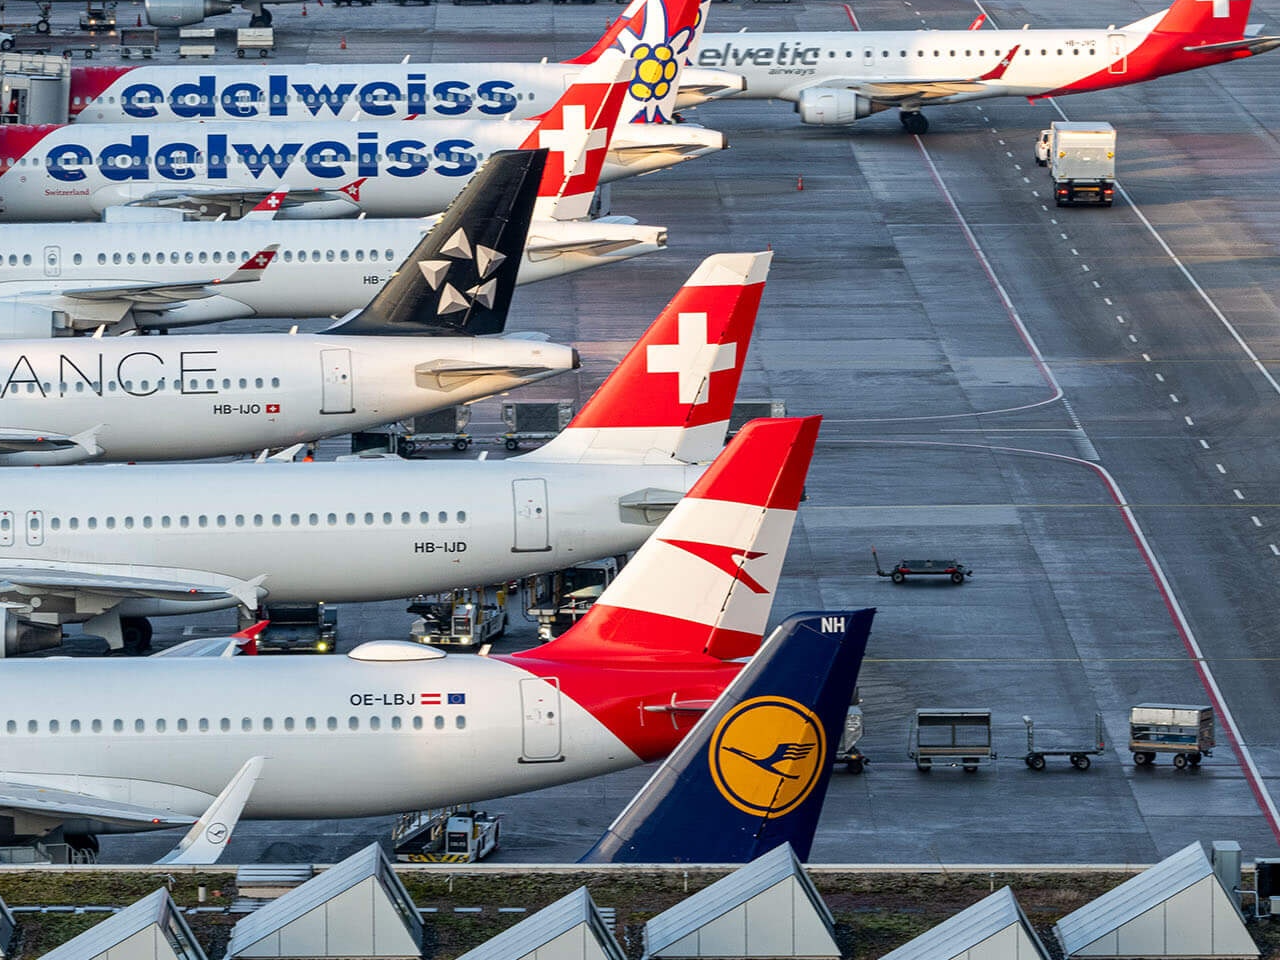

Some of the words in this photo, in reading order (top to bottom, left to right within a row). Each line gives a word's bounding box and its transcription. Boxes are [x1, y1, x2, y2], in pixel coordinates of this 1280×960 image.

[698, 42, 821, 66] elvetic
[768, 68, 816, 76] airways
[121, 74, 517, 118] edelweiss
[46, 132, 478, 182] edelweiss
[213, 404, 261, 414] HB-IJO
[415, 542, 467, 553] HB-IJD
[821, 617, 845, 633] NH
[350, 694, 415, 706] OE-LBJ
